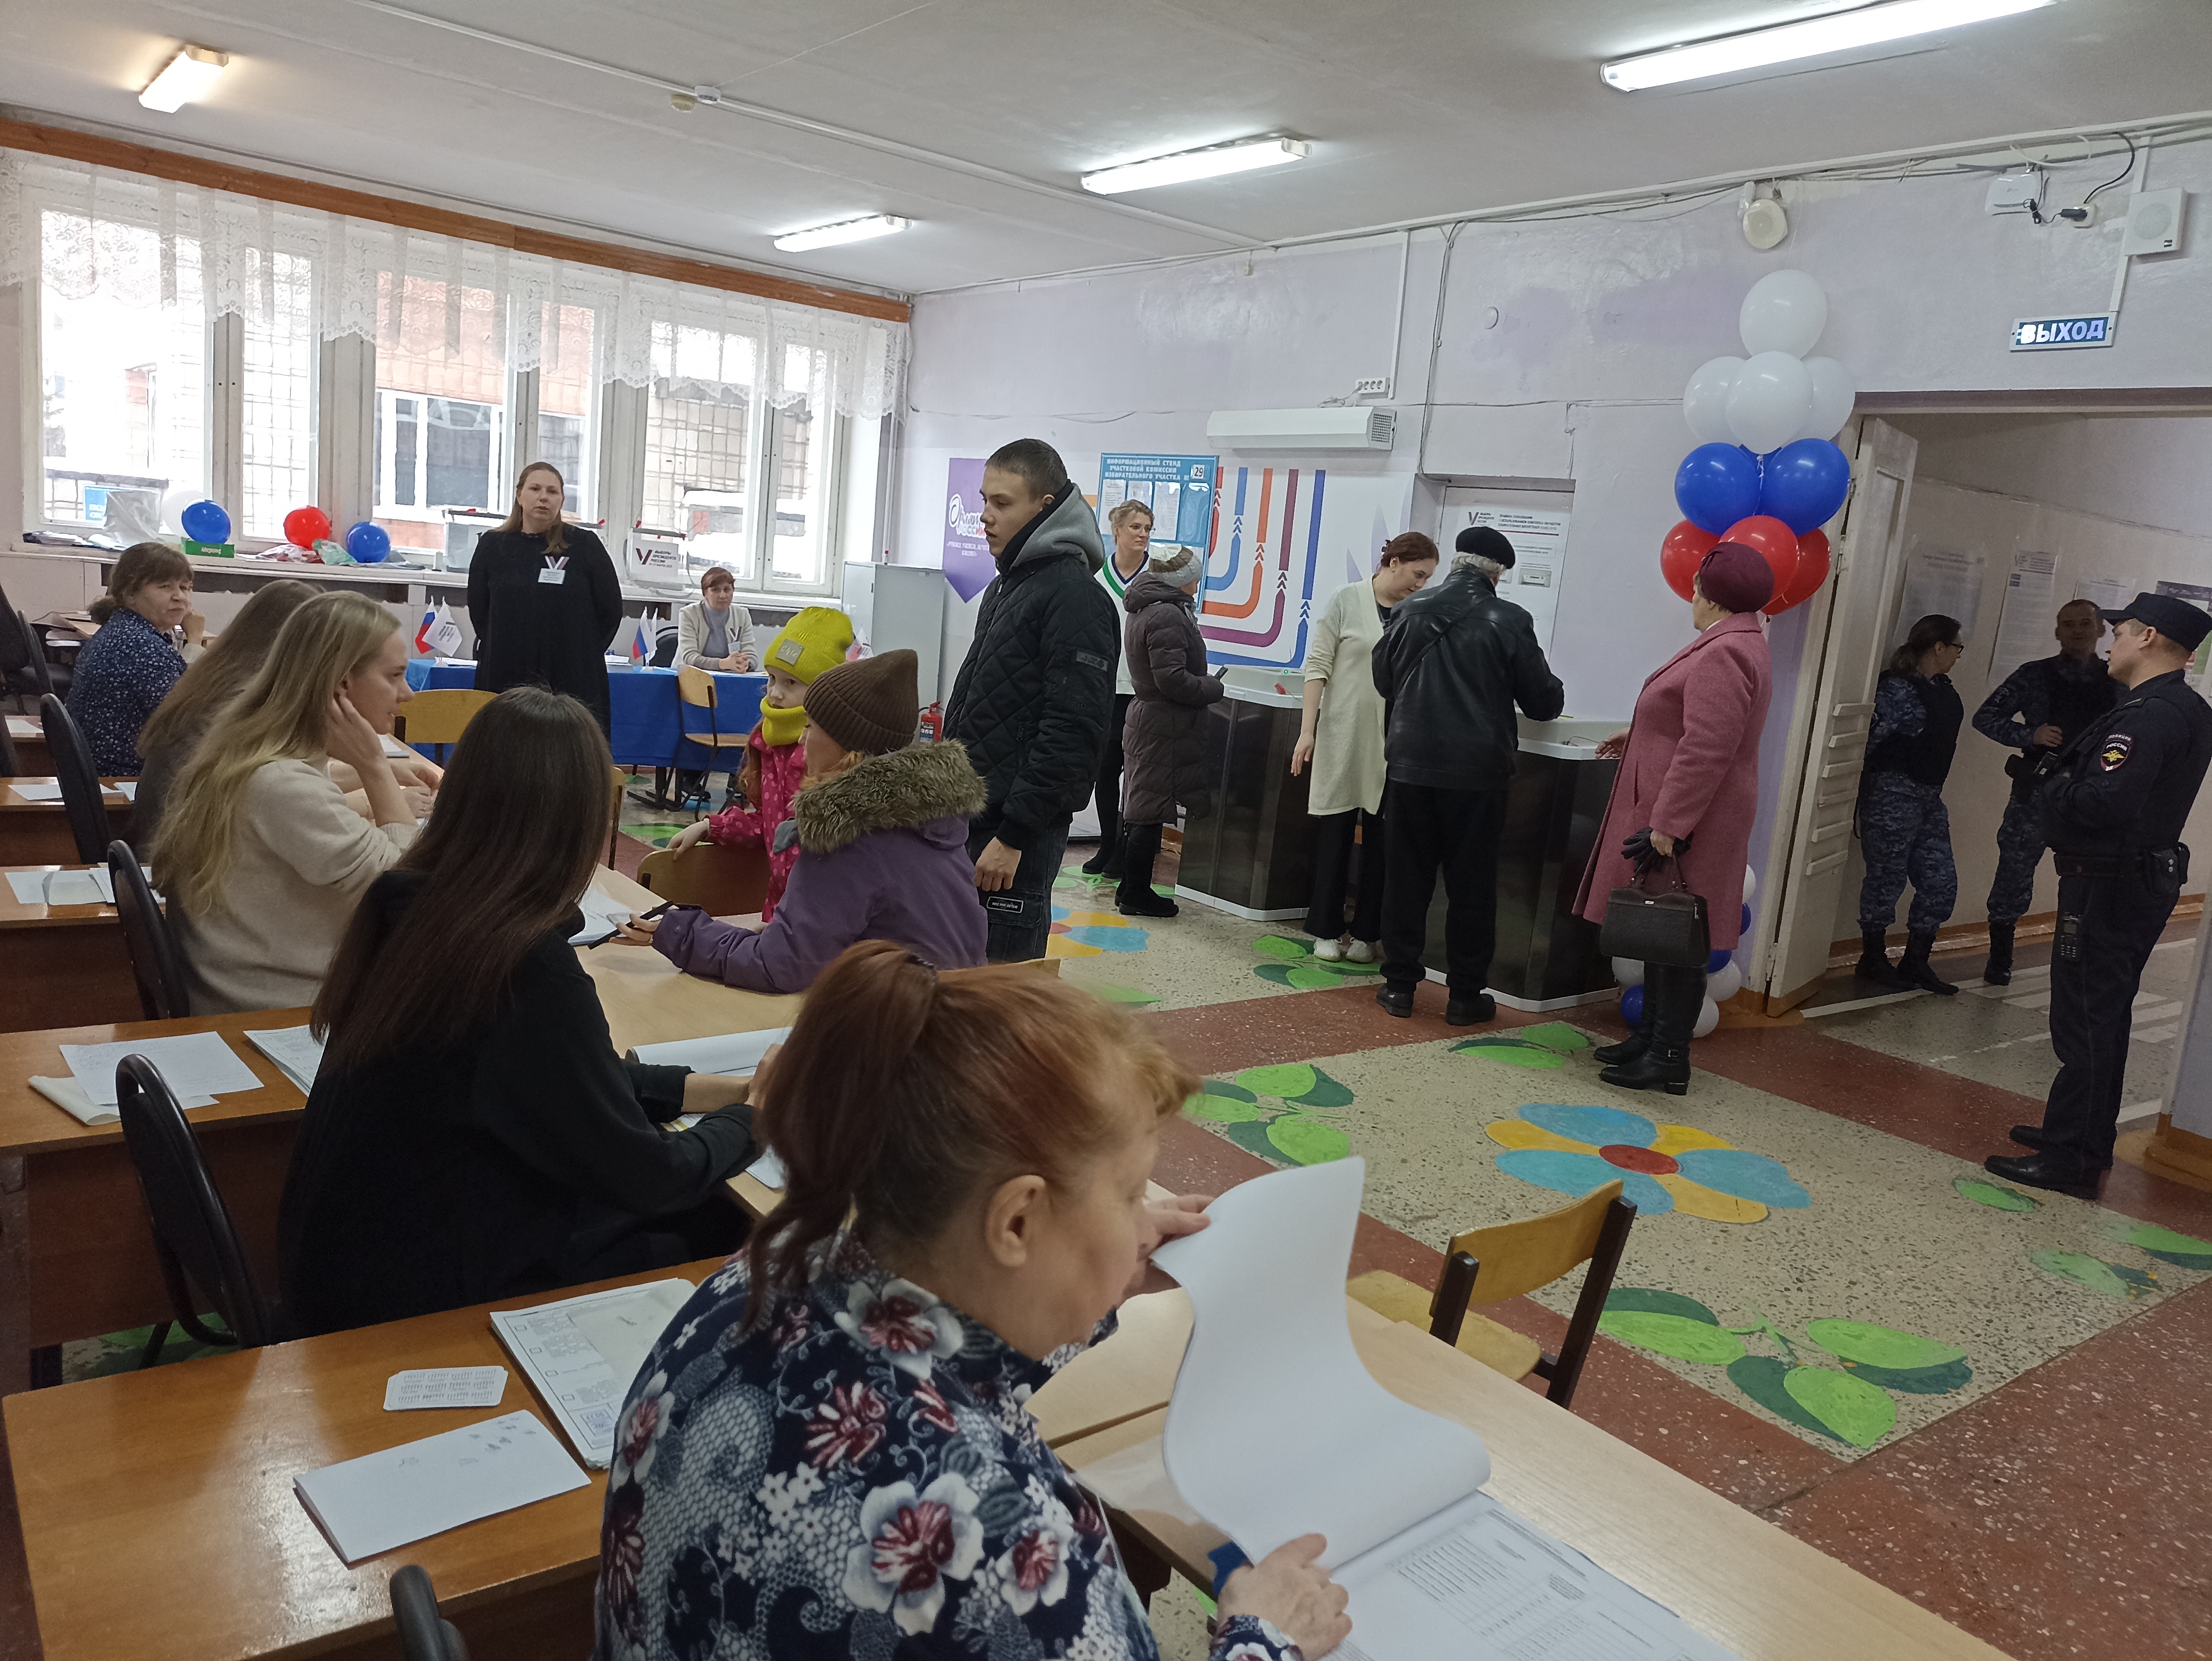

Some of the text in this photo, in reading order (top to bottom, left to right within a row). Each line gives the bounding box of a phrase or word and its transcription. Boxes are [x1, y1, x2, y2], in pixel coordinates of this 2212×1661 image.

[2020, 320, 2104, 344] ВЫХОД
[1194, 466, 1204, 477] 29
[2106, 742, 2127, 751] РОССИЯ
